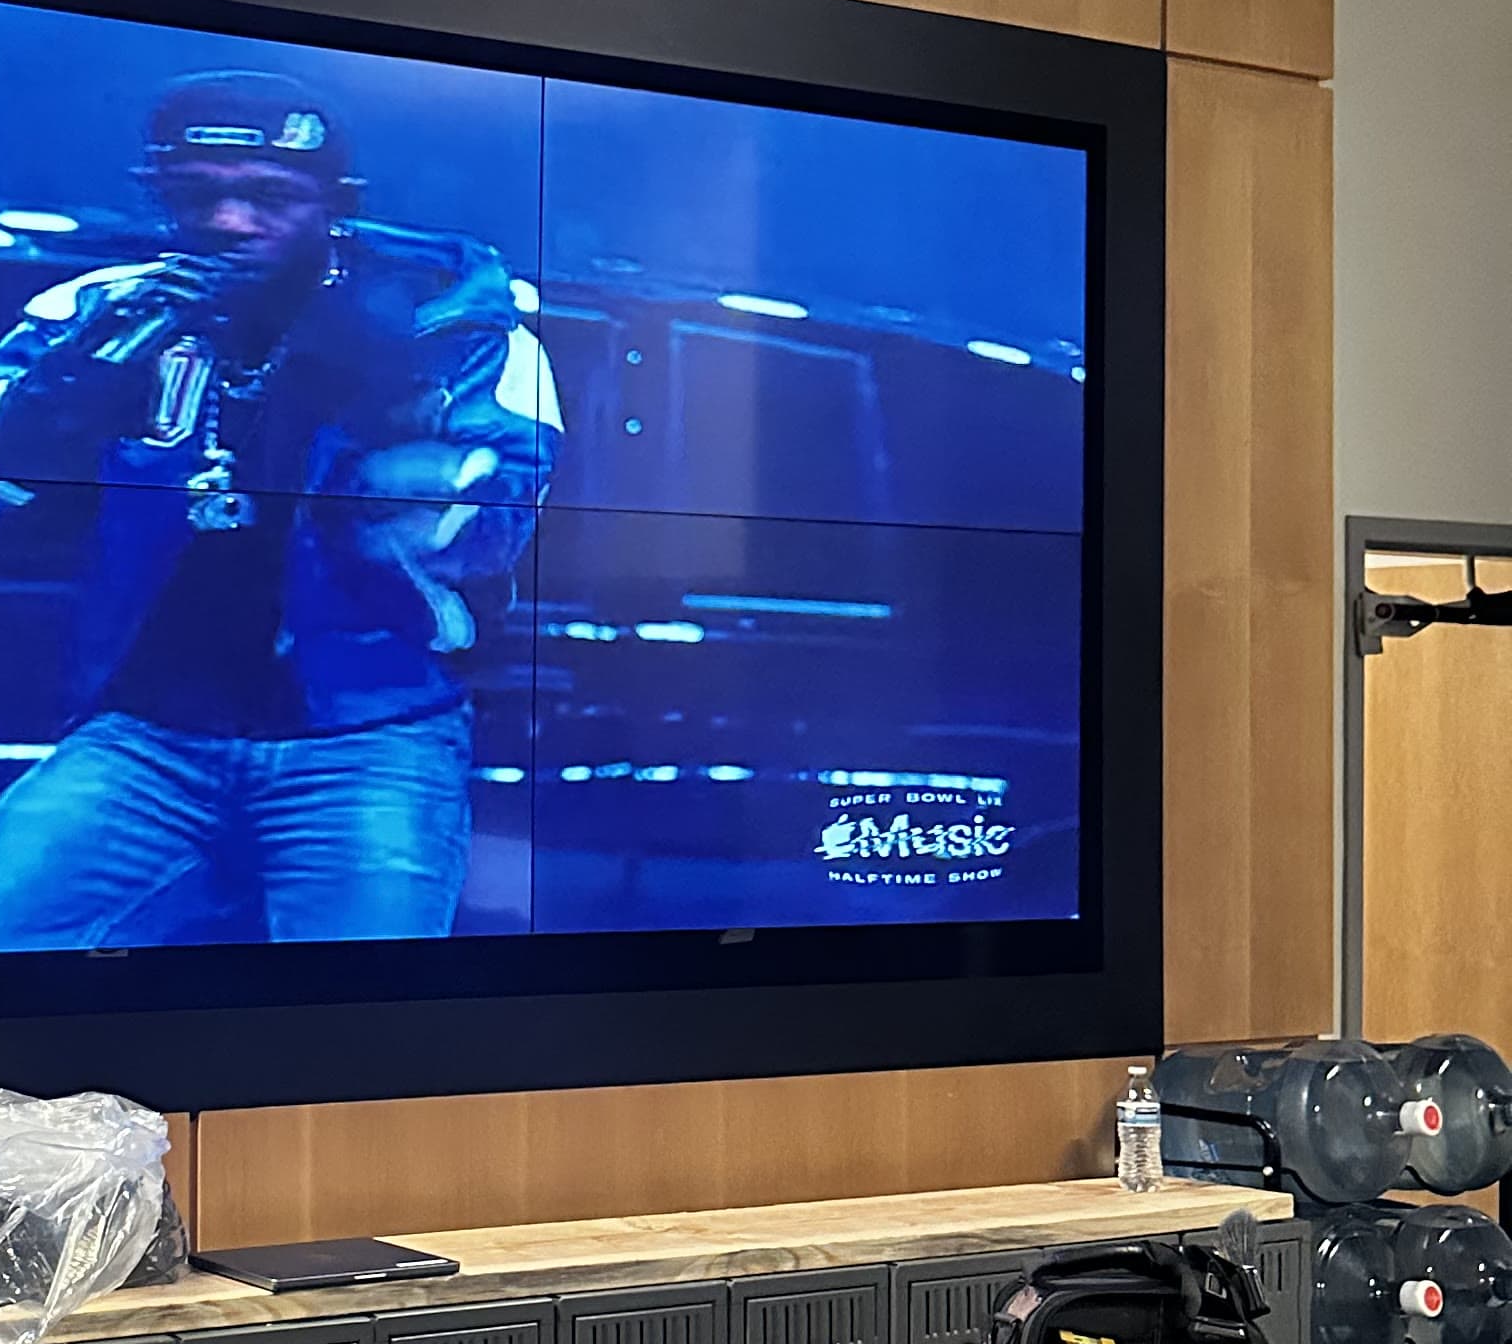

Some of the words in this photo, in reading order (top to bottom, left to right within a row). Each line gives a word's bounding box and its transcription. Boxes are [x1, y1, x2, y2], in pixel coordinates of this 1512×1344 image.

[829, 793, 892, 808] SUPER
[906, 793, 967, 805] BOWL
[828, 870, 936, 884] HALFTIME
[948, 867, 1003, 883] SHOW
